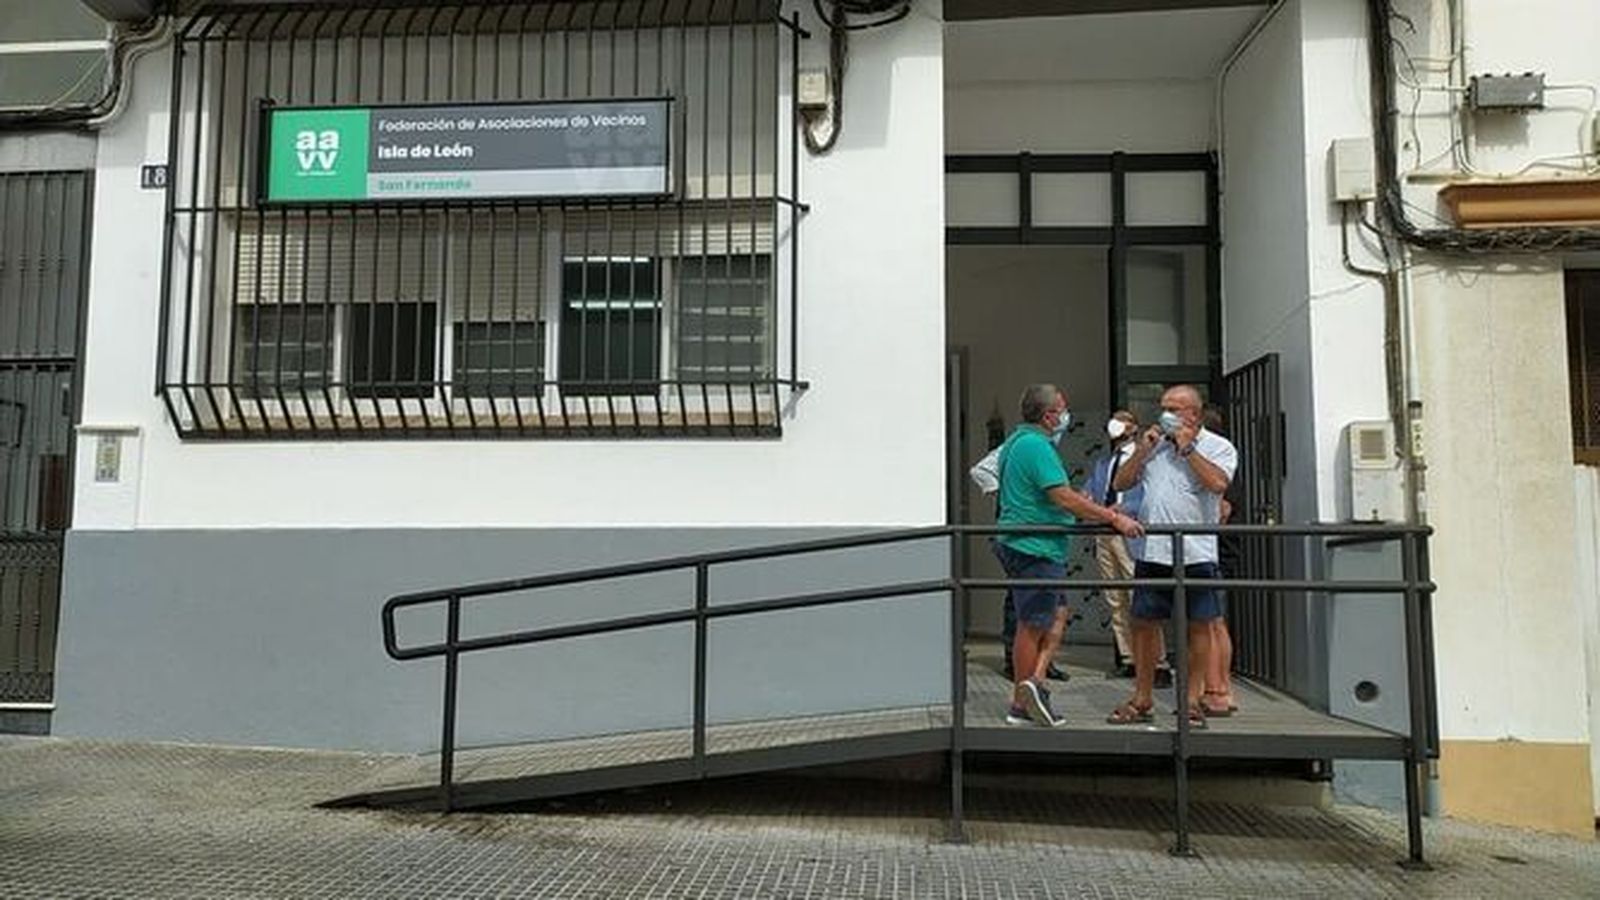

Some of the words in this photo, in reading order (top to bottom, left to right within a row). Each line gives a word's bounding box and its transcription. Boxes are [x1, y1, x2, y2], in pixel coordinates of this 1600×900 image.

[378, 117, 456, 132] Federación
[458, 118, 475, 131] de
[477, 115, 569, 130] Asociaciones
[570, 115, 589, 128] de
[590, 114, 647, 127] Vecinos
[296, 130, 339, 150] aa
[378, 144, 408, 159] Isla
[410, 143, 432, 158] de
[433, 142, 474, 158] León
[143, 167, 167, 186] 18
[378, 179, 404, 192] San
